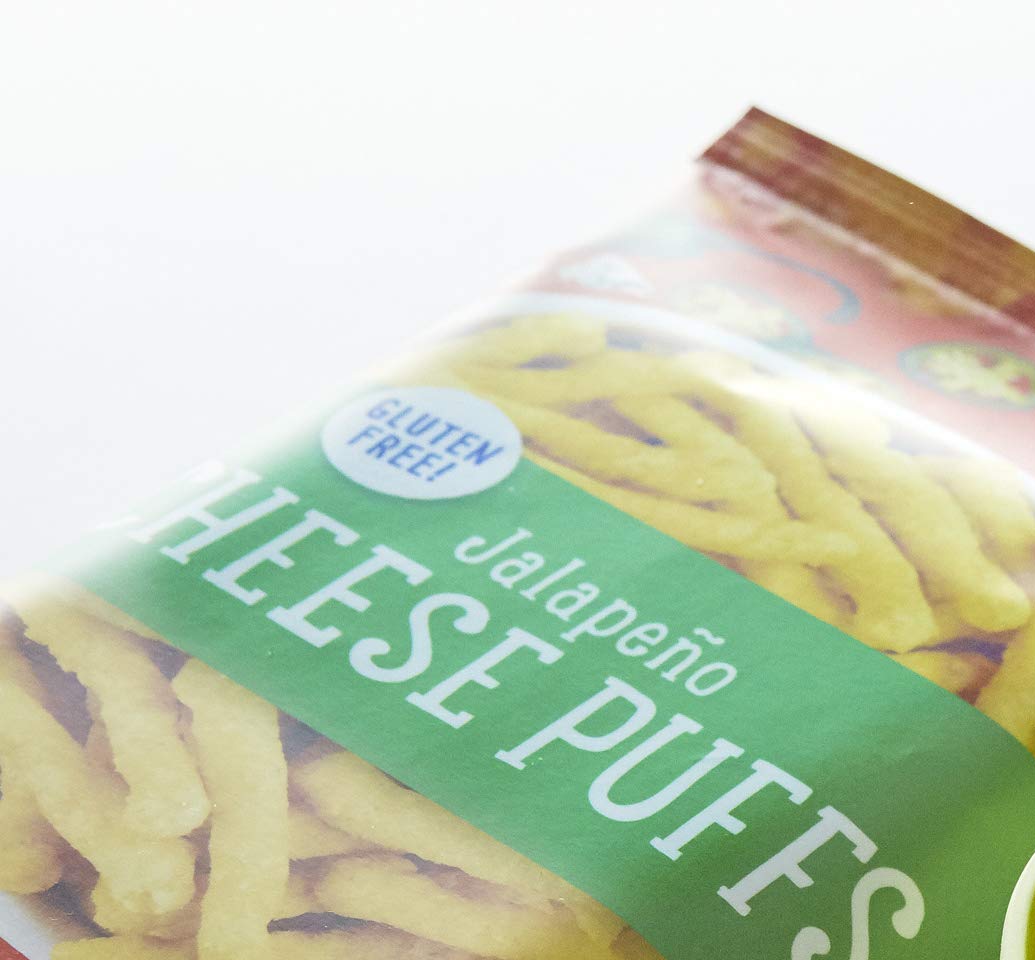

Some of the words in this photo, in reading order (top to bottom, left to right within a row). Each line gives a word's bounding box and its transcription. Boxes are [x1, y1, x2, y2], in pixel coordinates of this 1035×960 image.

[347, 424, 457, 482] FREE!
[368, 398, 505, 466] GLUTEN
[454, 528, 738, 697] Jalapeño
